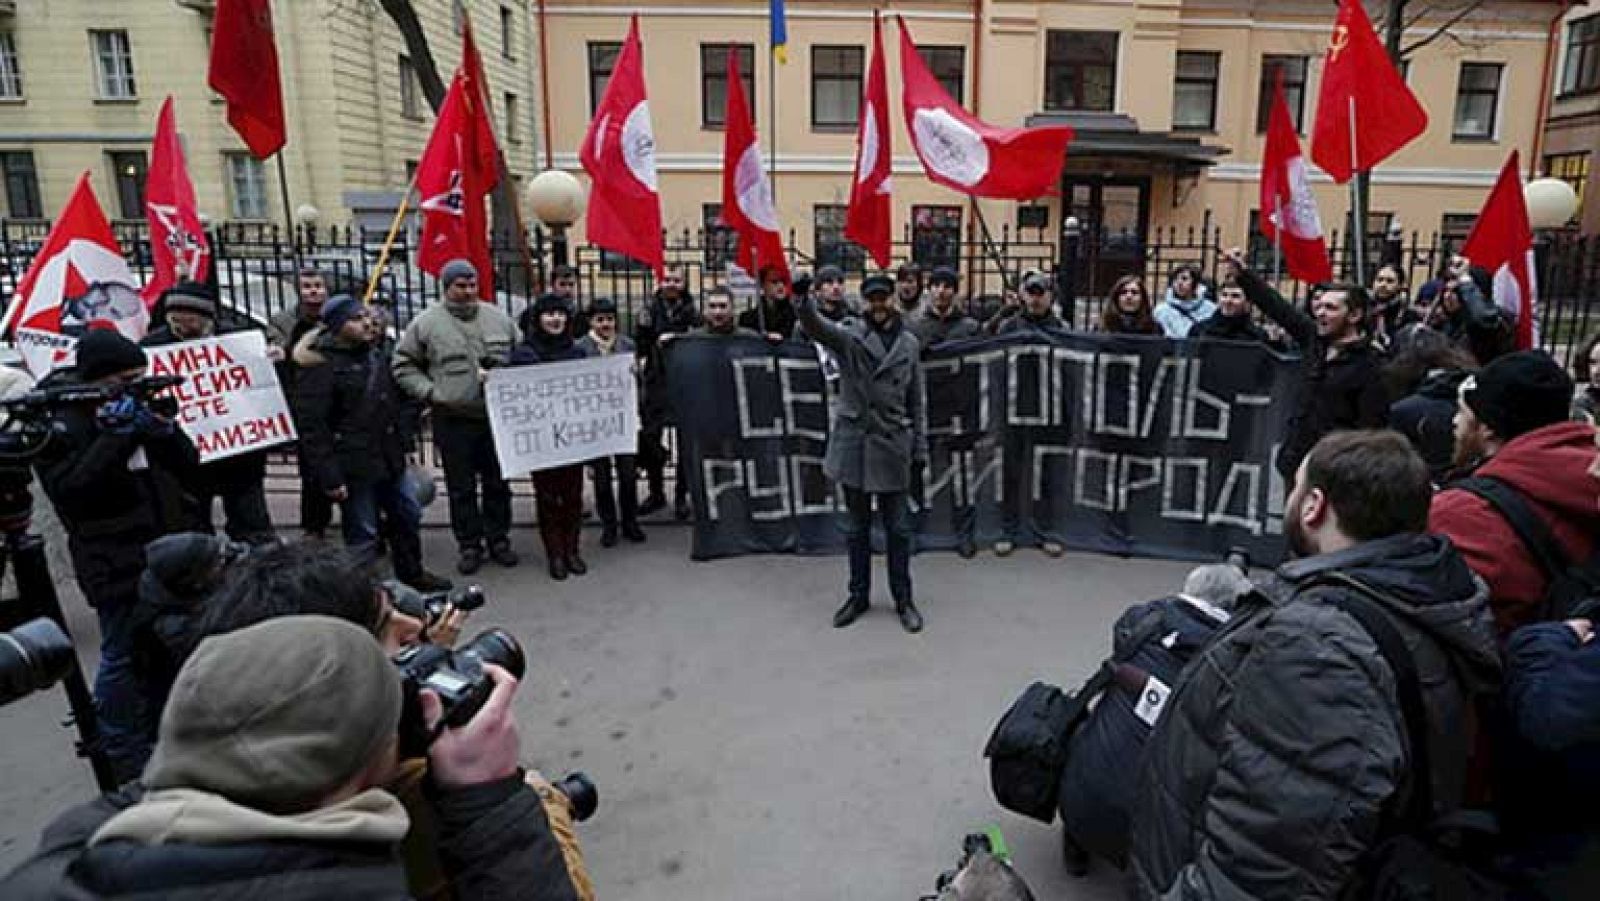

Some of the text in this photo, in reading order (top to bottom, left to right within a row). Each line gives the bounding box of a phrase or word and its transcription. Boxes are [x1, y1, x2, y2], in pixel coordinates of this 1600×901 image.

[153, 344, 235, 376] АИНА
[160, 365, 252, 401] ССИЯ
[732, 345, 1272, 440] СЕСТОПОЛЬ-
[180, 396, 229, 424] СТЕ
[197, 412, 292, 453] АЛИЗМ!
[514, 428, 540, 455] ОТ
[703, 437, 1004, 521] РУСИЙ
